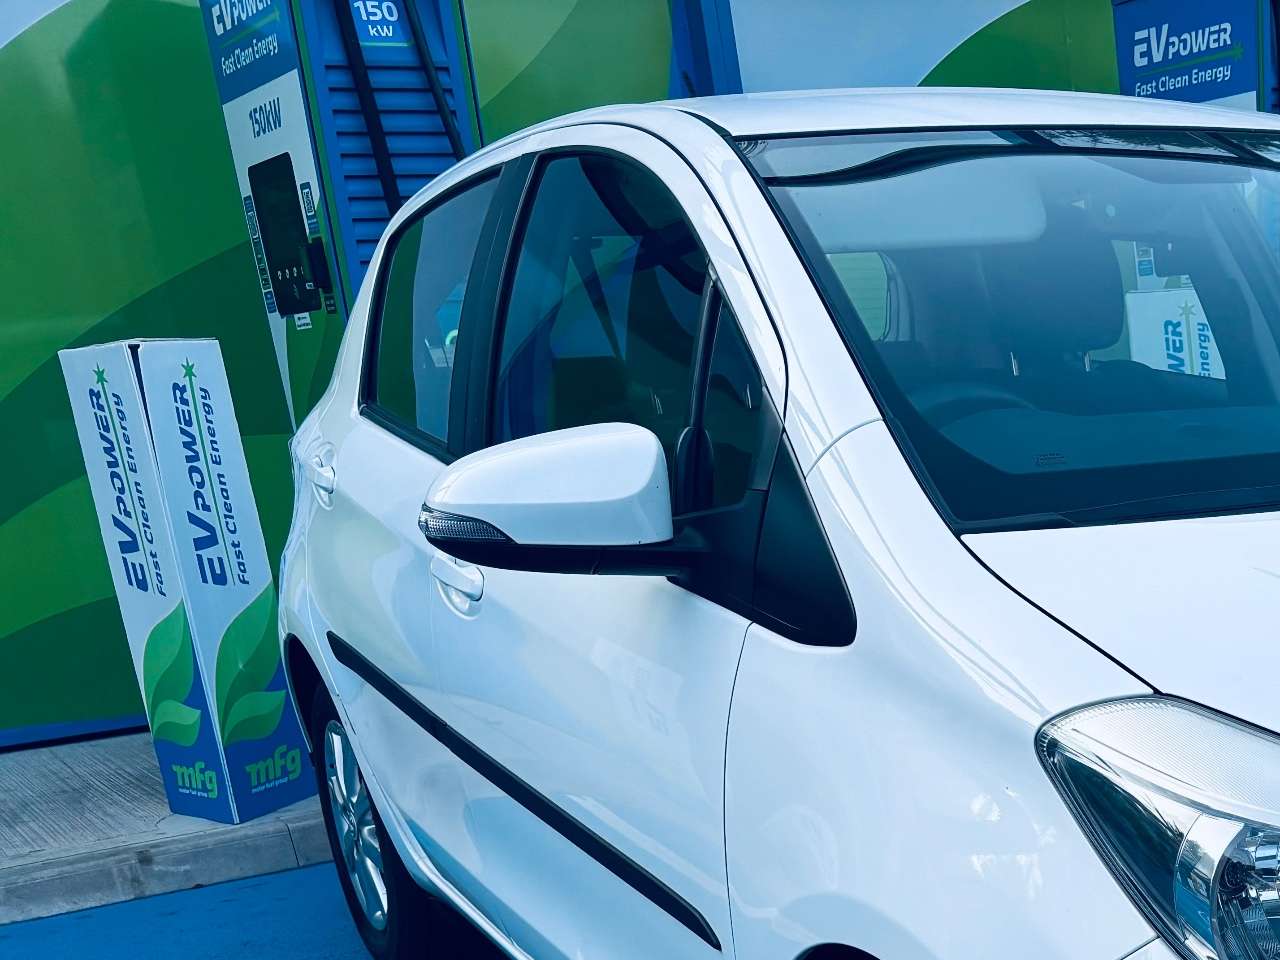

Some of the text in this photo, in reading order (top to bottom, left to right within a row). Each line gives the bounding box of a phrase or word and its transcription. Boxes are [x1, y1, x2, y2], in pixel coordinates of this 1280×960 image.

[353, 1, 399, 21] 150
[368, 25, 392, 36] kW
[221, 33, 278, 76] Fast Clean Energy
[1135, 63, 1231, 97] Fast Clean Energy
[249, 97, 282, 138] 150kW
[1197, 323, 1211, 377] nergy
[112, 392, 167, 597] Fast Clean Energy
[199, 387, 250, 585] Fast Clean Energy
[172, 761, 218, 798] mfg
[245, 745, 302, 780] mfg
